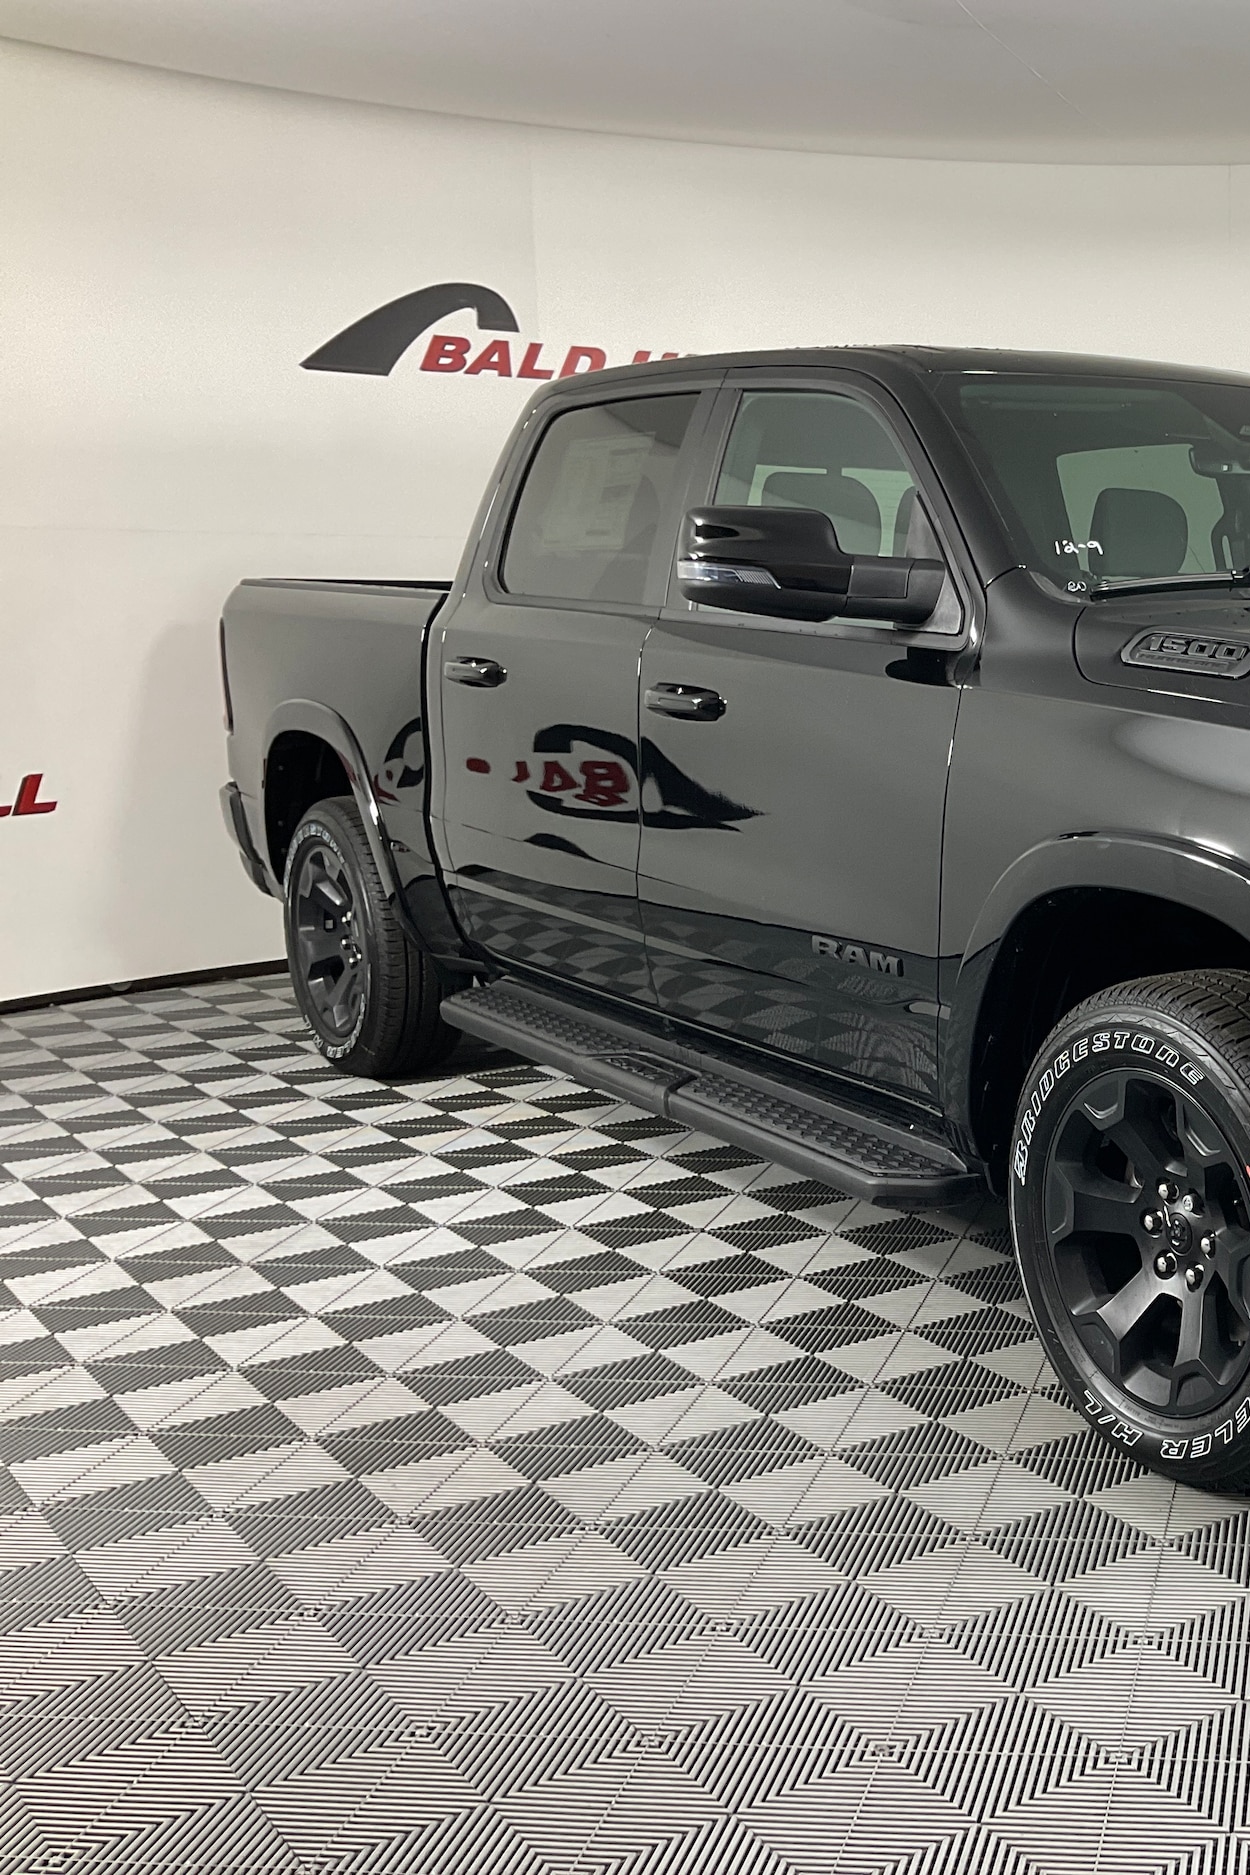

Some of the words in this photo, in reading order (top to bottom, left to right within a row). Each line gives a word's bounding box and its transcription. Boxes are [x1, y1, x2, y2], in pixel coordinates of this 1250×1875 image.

[1148, 635, 1247, 661] 1500
[811, 934, 905, 978] RAM
[1014, 1031, 1206, 1187] BRIDGESTONE
[1083, 1389, 1144, 1447] H/L
